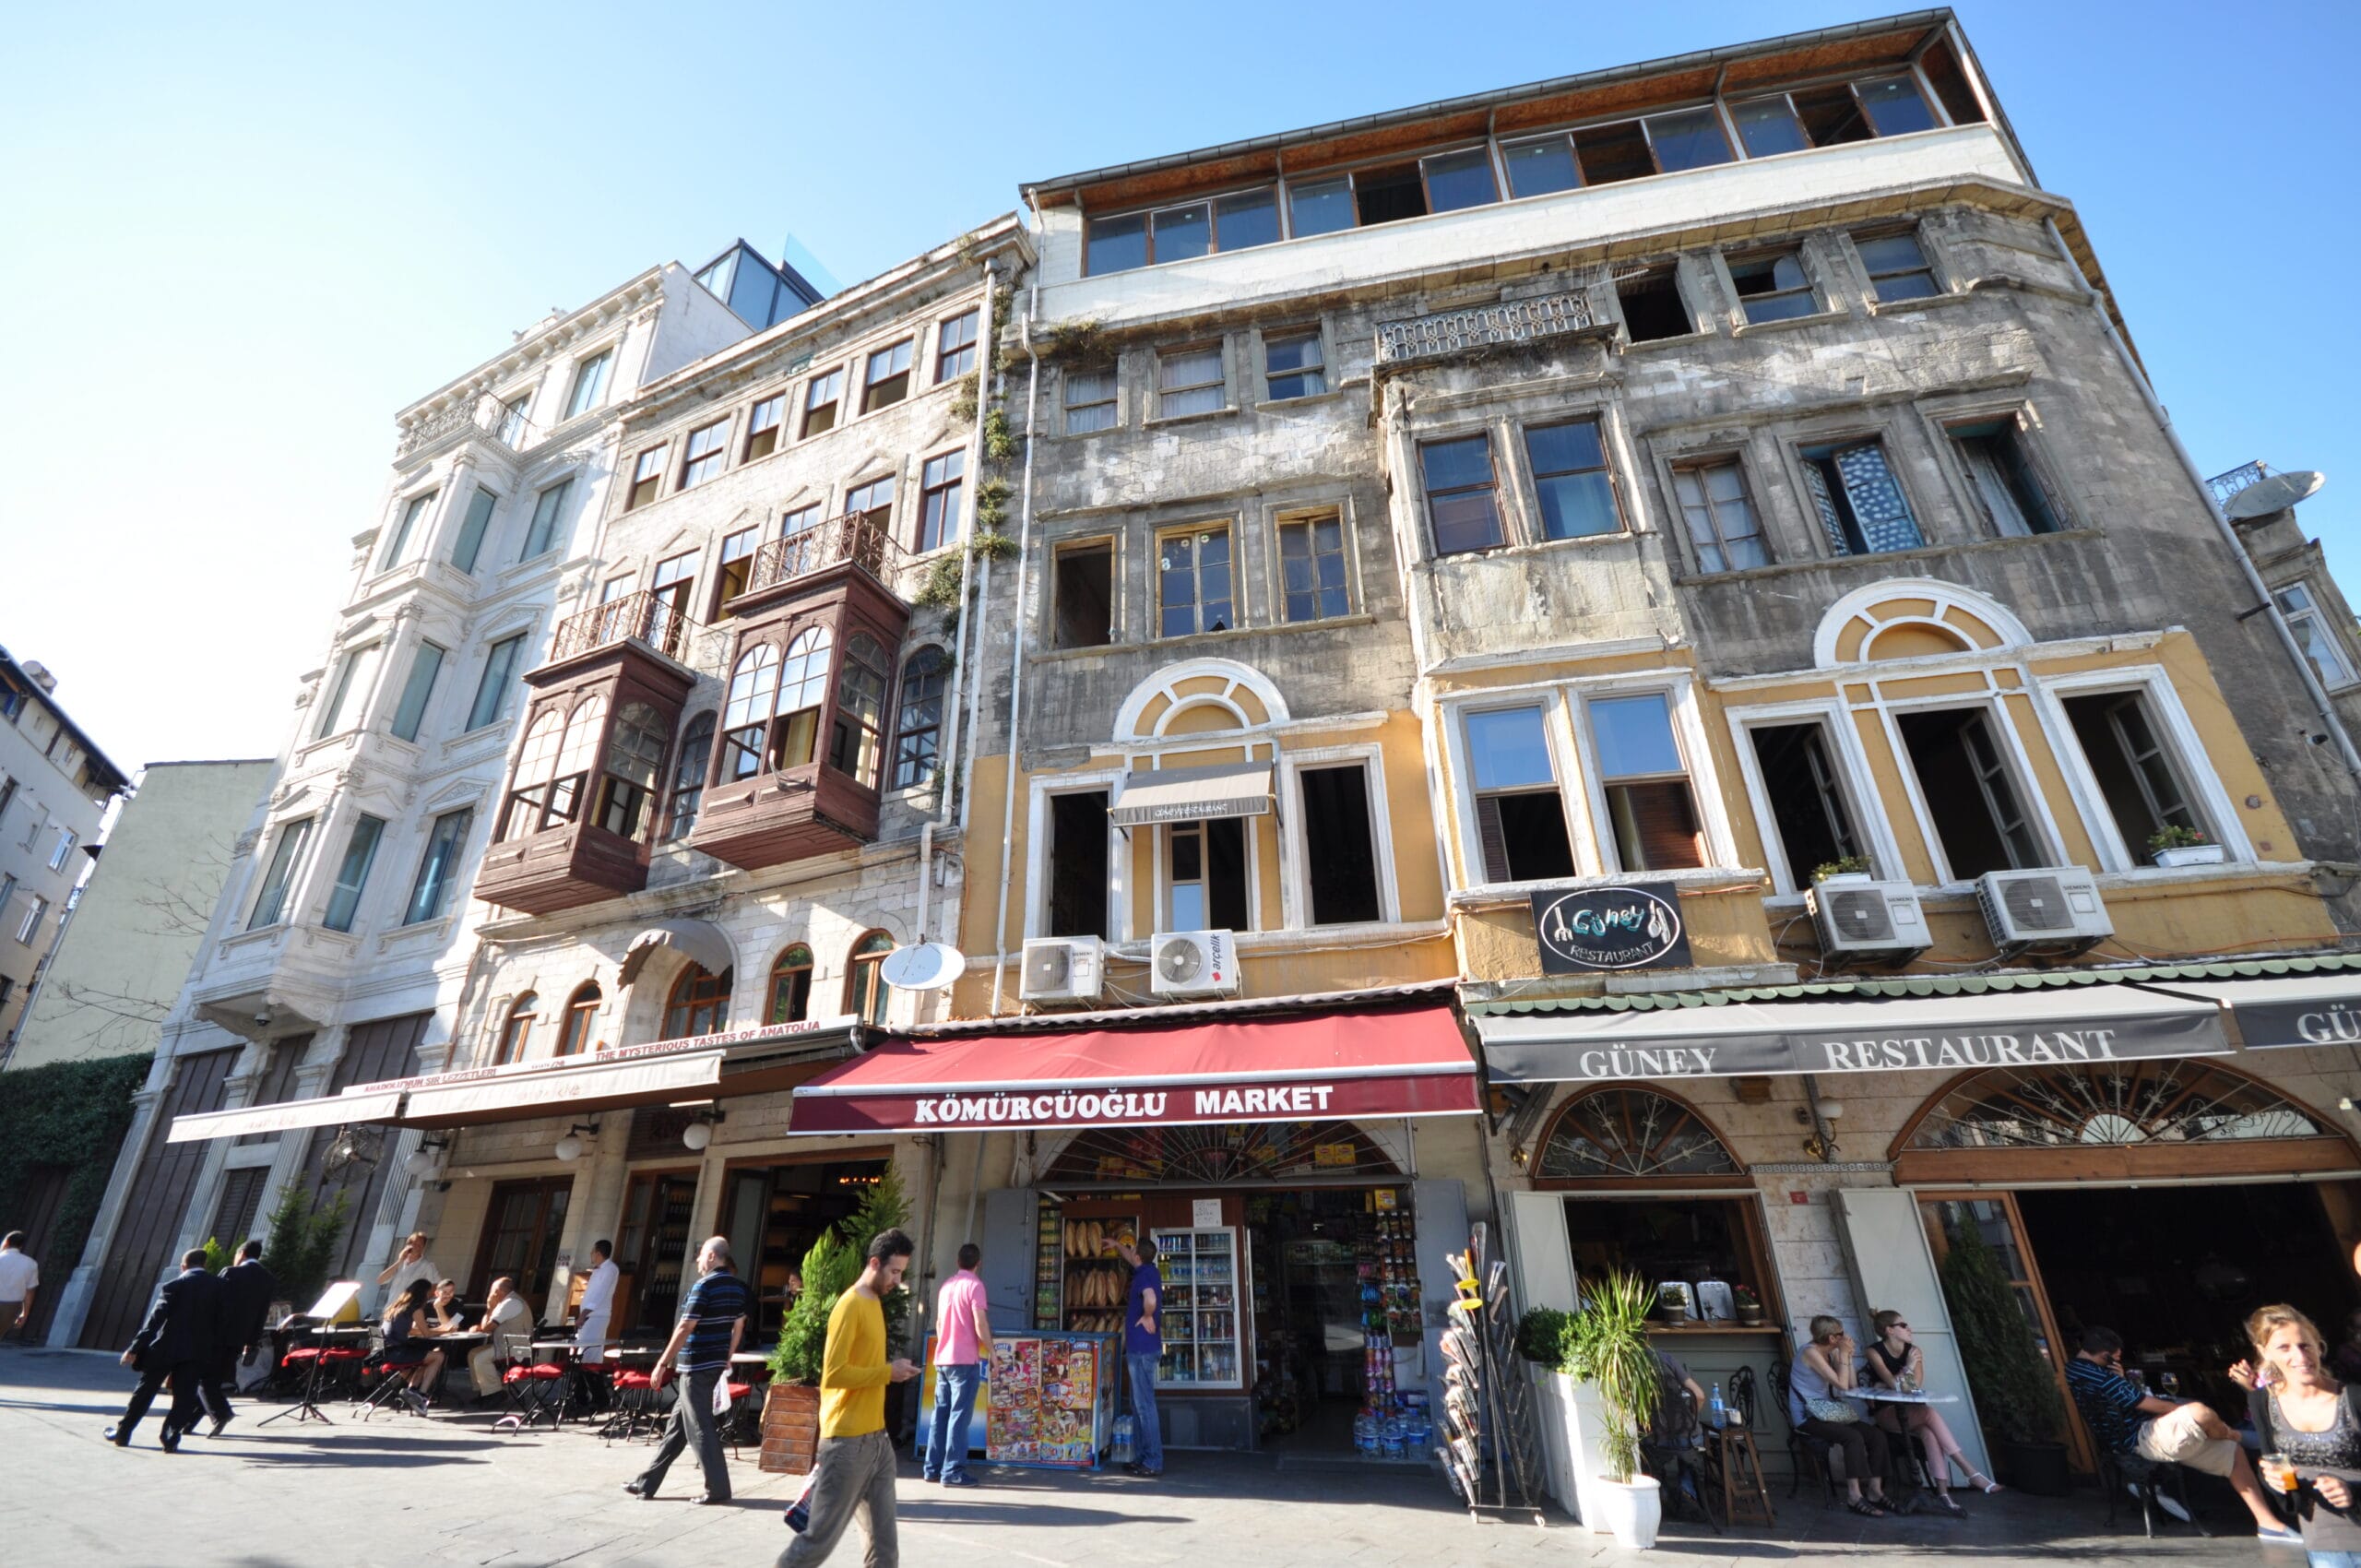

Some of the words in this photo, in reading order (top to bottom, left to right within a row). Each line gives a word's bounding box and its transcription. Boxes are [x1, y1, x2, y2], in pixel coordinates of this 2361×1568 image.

[1572, 905, 1644, 936] Güney
[1210, 934, 1221, 970] arçelik
[1570, 942, 1654, 963] RESTAURANT
[595, 1051, 615, 1062] THE
[619, 1039, 690, 1057] MYSTERIOUS
[694, 1033, 736, 1047] TASTES
[740, 1029, 755, 1040] OF
[760, 1021, 820, 1039] ANATOLIA
[2296, 1004, 2361, 1043] GÜ
[1580, 1043, 1717, 1077] GÜNEY
[1821, 1029, 2115, 1070] RESTAURANT
[914, 1087, 1168, 1123] KÖMÜRCÜOĞLU
[1195, 1086, 1333, 1114] MARKET
